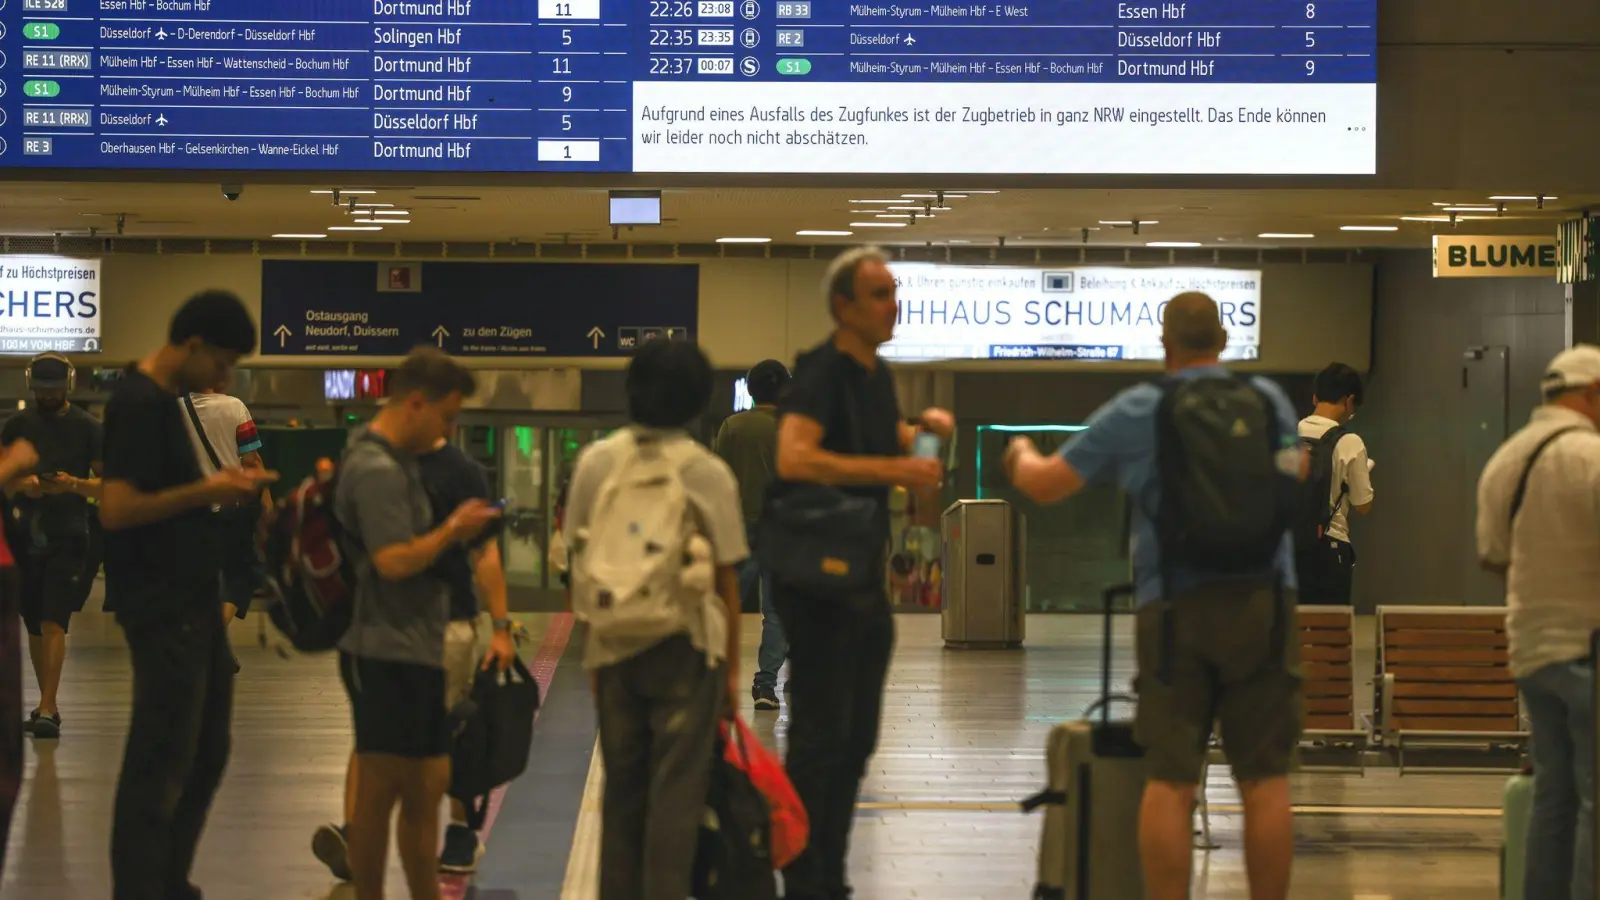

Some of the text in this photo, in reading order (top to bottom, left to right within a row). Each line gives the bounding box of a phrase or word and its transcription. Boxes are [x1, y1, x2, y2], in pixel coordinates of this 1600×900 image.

[25, 0, 64, 8] ICE 528
[100, 0, 126, 9] Essen
[130, 0, 146, 10] Hbf
[157, 0, 191, 10] Bochum
[194, 0, 210, 10] Hbf
[375, 0, 471, 15] Dortmund Hbf
[556, 3, 572, 16] 11
[650, 1, 692, 17] 22:26
[701, 3, 731, 14] 23:08
[779, 5, 808, 15] RB 33
[1119, 3, 1185, 18] Essen Hbf
[851, 5, 921, 18] Mülheim-Styrum
[931, 5, 967, 16] Mülheim
[970, 6, 986, 16] Hbf
[1005, 6, 1028, 16] West
[1306, 4, 1315, 18] 8
[34, 26, 48, 37] S1
[100, 27, 151, 38] Düsseldorf
[178, 28, 235, 39] D-Derendorf
[245, 29, 295, 40] Düsseldorf
[299, 30, 315, 40] Hbf
[375, 28, 461, 47] Solingen Hbf
[563, 30, 571, 45] 5
[650, 30, 692, 45] 22:35
[701, 32, 730, 42] 23:35
[779, 33, 800, 44] RE 2
[851, 33, 899, 44] Düsseldorf
[1119, 32, 1221, 47] Düsseldorf Hbf
[1306, 32, 1314, 47] 5
[26, 55, 88, 68] RE 11 (RRX)
[101, 56, 137, 67] Mülheim
[141, 56, 157, 67] Hbf
[168, 57, 194, 68] Essen
[197, 57, 213, 68] Hbf
[224, 57, 286, 69] Wattenscheid
[296, 58, 329, 69] Bochum
[333, 58, 349, 69] Hbf
[375, 56, 471, 72] Dortmund Hbf
[553, 58, 571, 73] 11
[650, 58, 692, 73] 22:37
[701, 60, 730, 70] 00:07
[787, 62, 800, 72] S1
[1119, 60, 1214, 75] Dortmund Hbf
[1306, 60, 1314, 75] 9
[851, 62, 921, 75] Mülheim-Styrum
[931, 62, 967, 73] Mülheim
[970, 62, 985, 73] Hbf
[996, 62, 1021, 73] Essen
[1025, 62, 1040, 73] Hbf
[1051, 62, 1084, 73] Bochum
[1087, 63, 1103, 73] Hbf
[35, 84, 48, 95] S1
[101, 84, 173, 98] Mülheim-Styrum
[184, 86, 220, 96] Mülheim
[224, 86, 239, 97] Hbf
[250, 86, 276, 97] Essen
[280, 87, 295, 97] Hbf
[306, 87, 339, 98] Bochum
[343, 87, 359, 98] Hbf
[375, 85, 471, 101] Dortmund Hbf
[563, 87, 571, 102] 9
[27, 112, 88, 125] RE 11 (RRX)
[101, 113, 151, 124] Düsseldorf
[374, 113, 477, 129] Düsseldorf Hbf
[563, 115, 571, 130] 5
[642, 106, 1325, 126] Aufgrund eines Ausfalls des Zugfunkes ist der Zugbetrieb in ganz NRW eingestellt. Das Ende können
[642, 129, 867, 144] wir leider noch nicht abschätzen.
[27, 141, 49, 152] RE 3
[101, 142, 155, 153] Oberhausen
[159, 143, 175, 153] Hbf
[186, 143, 248, 154] Gelsenkirchen
[259, 144, 319, 155] Wanne-Eickel
[323, 144, 338, 155] Hbf
[374, 142, 470, 158] Dortmund Hbf
[564, 146, 571, 158] 1
[7, 269, 18, 278] zu
[22, 266, 95, 282] Höchstpreisen
[0, 291, 97, 318] HERS
[306, 310, 368, 323] Ostausgang
[897, 300, 1256, 326] IHHAUS SCHUMARS
[0, 325, 96, 334] haus-schumachers.de
[306, 325, 399, 337] Neudorf, Duissern
[463, 326, 532, 339] zu den Zügen
[620, 337, 635, 346] WC
